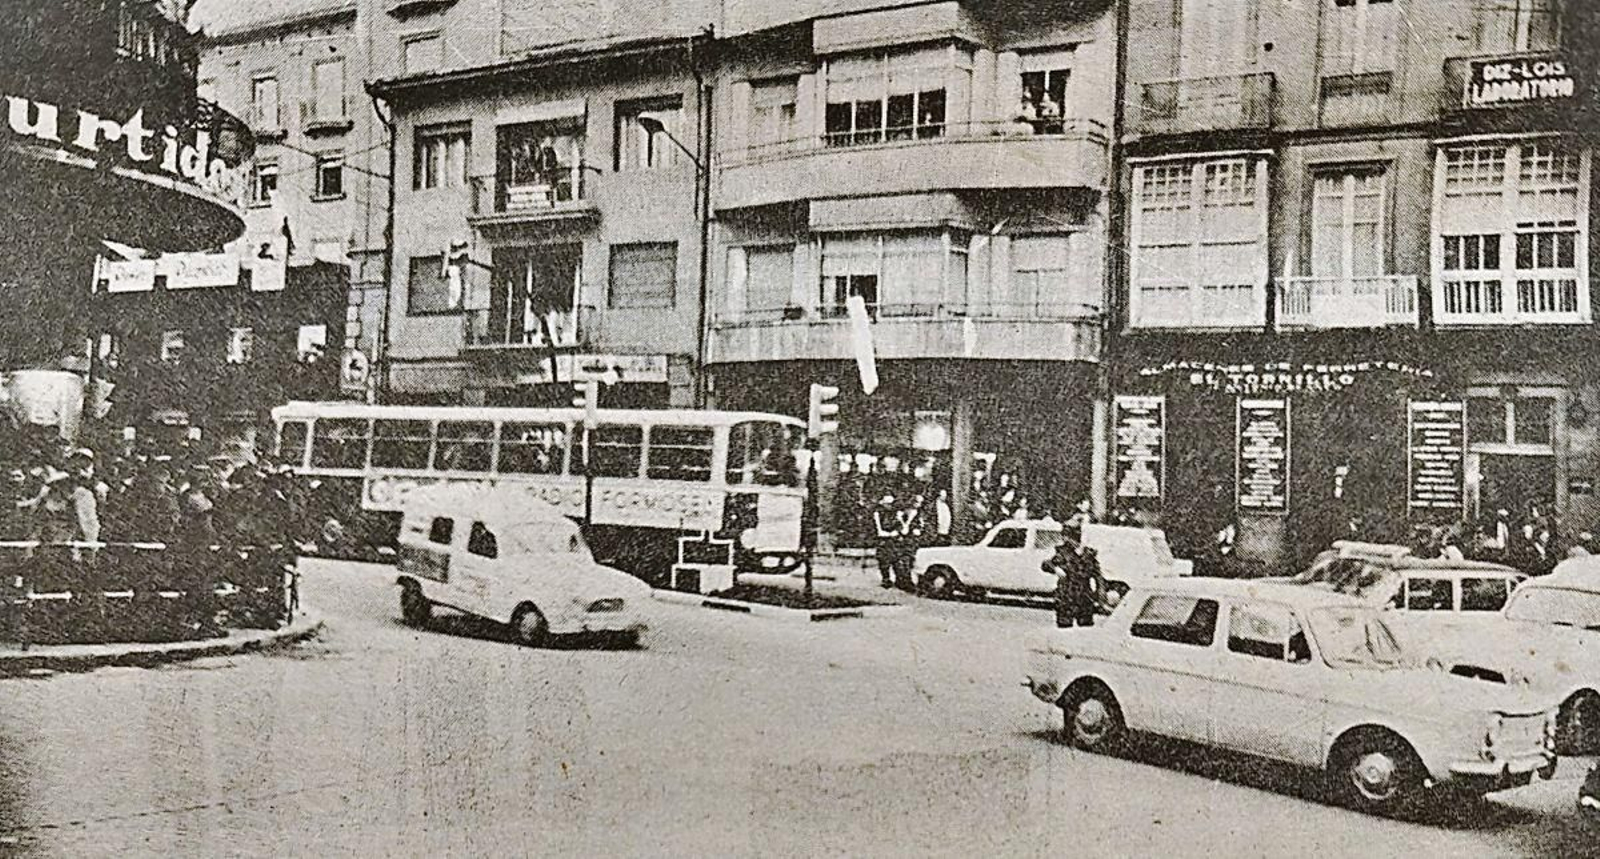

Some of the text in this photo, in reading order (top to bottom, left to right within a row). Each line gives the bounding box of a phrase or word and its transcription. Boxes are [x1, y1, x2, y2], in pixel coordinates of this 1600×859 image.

[1472, 77, 1574, 102] LABORATORIO
[1264, 362, 1291, 371] DE
[1226, 373, 1355, 385] TORNILLO
